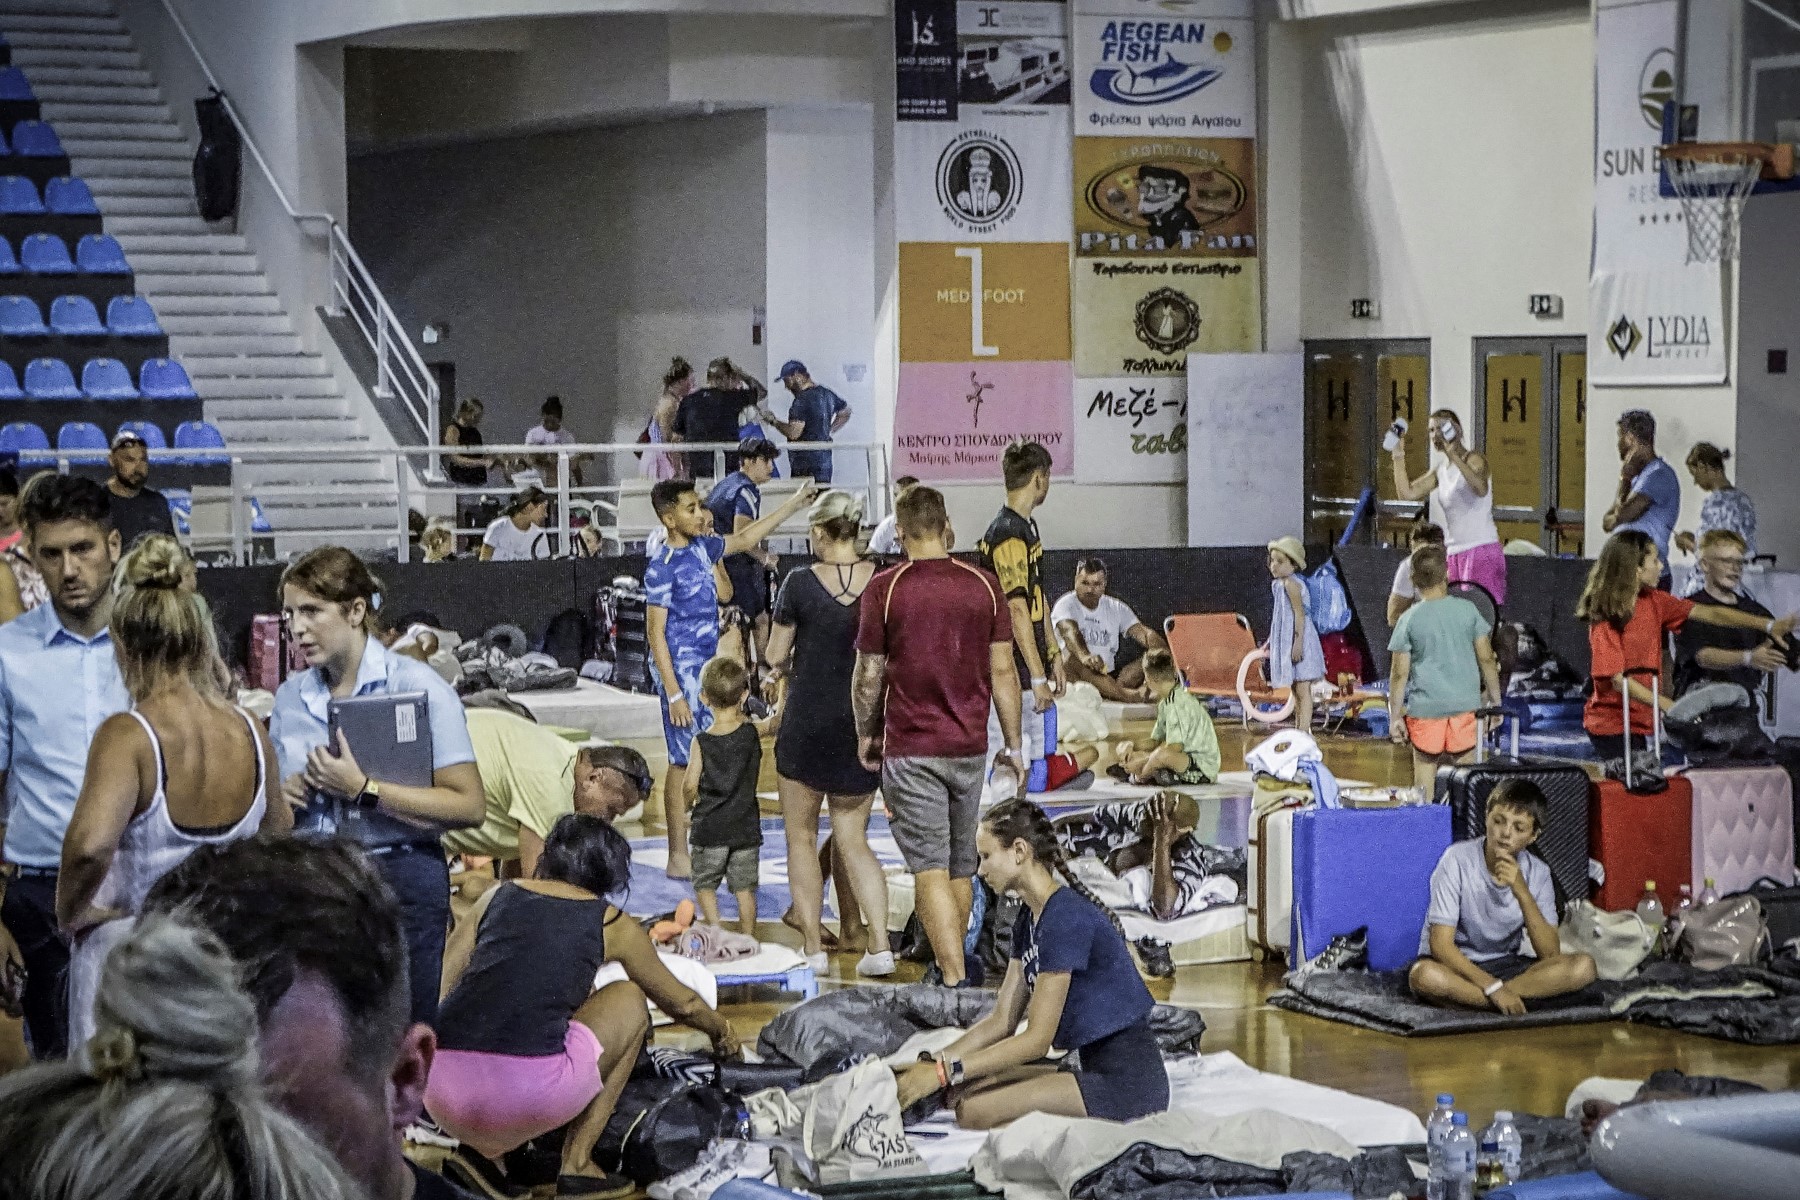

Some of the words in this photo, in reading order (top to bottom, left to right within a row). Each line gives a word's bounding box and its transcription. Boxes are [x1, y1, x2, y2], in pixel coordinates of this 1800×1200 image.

[1101, 21, 1206, 44] AEGEAN
[1102, 42, 1161, 63] FISH
[1089, 112, 1142, 127] Φρέσκα
[1148, 113, 1187, 128] ψάρια
[1191, 114, 1242, 129] Αιγαίου
[1603, 147, 1645, 177] SUN
[1647, 315, 1711, 358] LYDIA
[898, 434, 951, 448] ΚΕΝΤΡΟ
